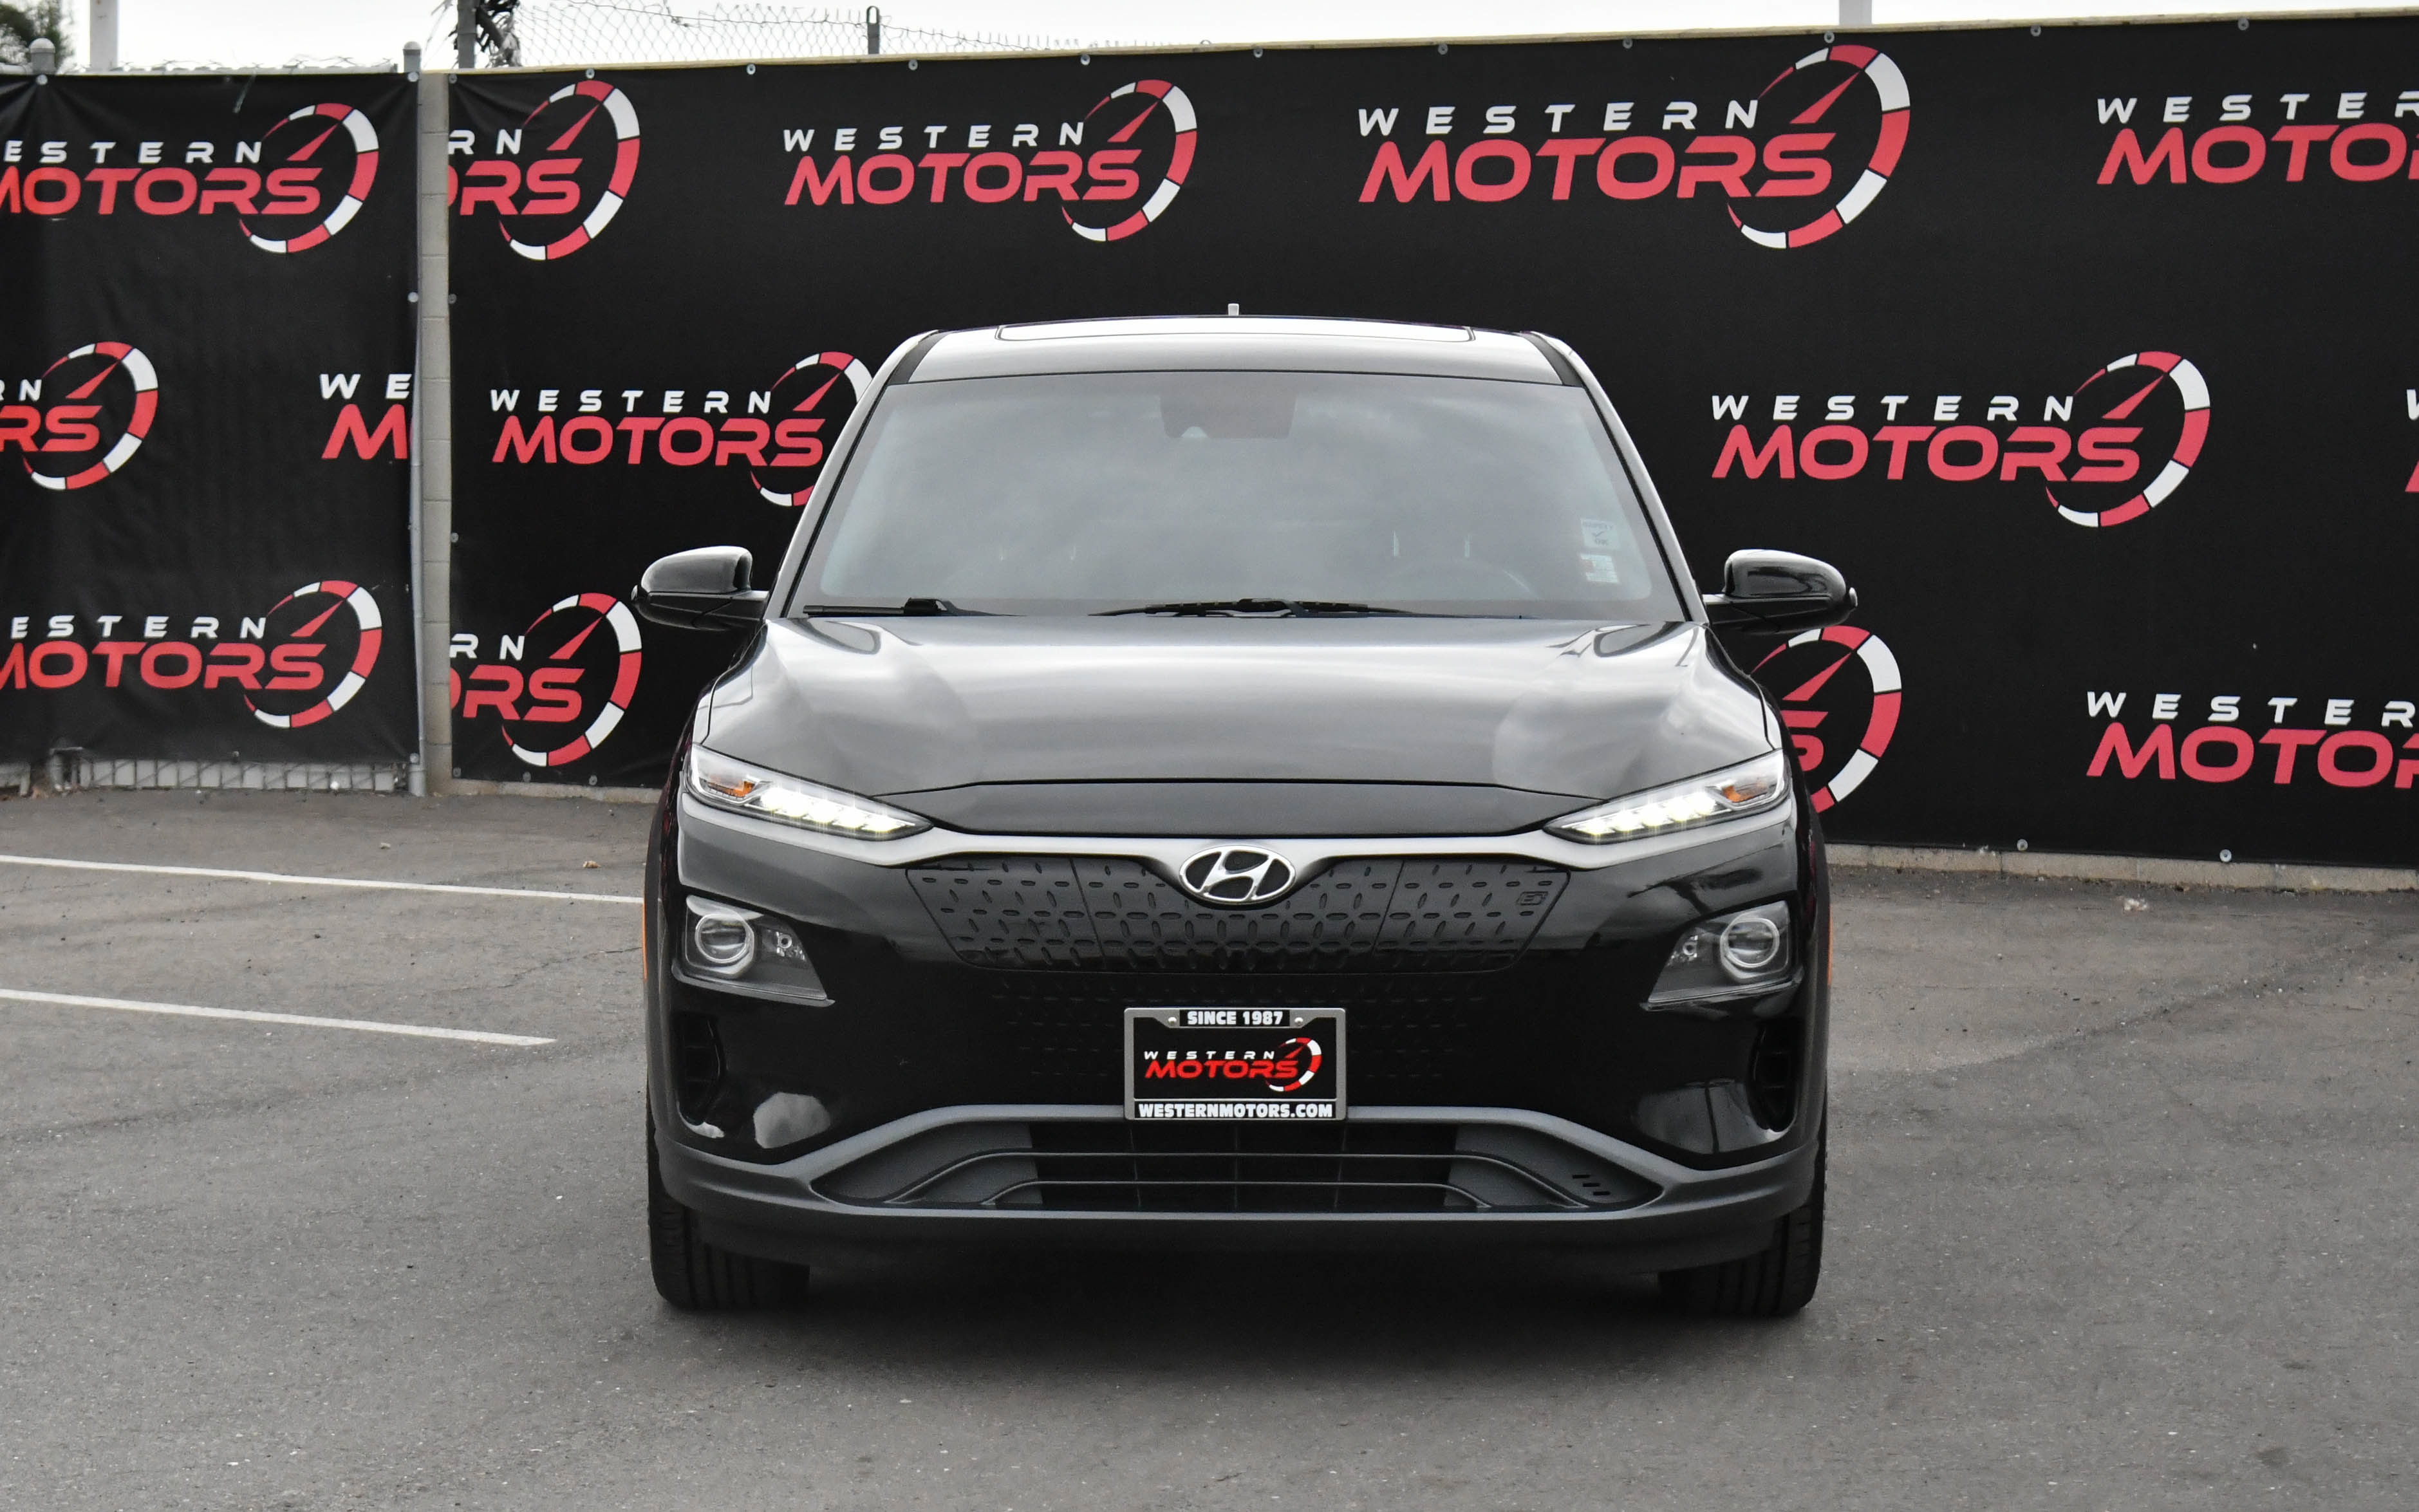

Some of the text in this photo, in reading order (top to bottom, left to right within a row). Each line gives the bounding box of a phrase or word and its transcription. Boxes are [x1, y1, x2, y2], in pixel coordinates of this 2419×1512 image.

[1358, 99, 1758, 136] WESTERN
[2097, 91, 2419, 124] WESTER
[4, 140, 262, 163] ESTERN
[448, 129, 522, 155] RN
[783, 122, 1084, 152] WESTERN
[1359, 132, 1836, 203] MOTORS
[2097, 123, 2419, 185] MOTO
[448, 158, 583, 216] RS
[784, 149, 1142, 206] MOTORS
[0, 379, 42, 402] N
[319, 373, 412, 400] WE
[490, 389, 771, 414] WESTERN
[1712, 395, 2073, 422] WESTERN
[321, 404, 413, 460] M
[492, 415, 826, 467] MOTORS
[1712, 424, 2143, 483] MOTORS
[10, 615, 266, 639] ESTERN
[449, 633, 525, 661] RN
[450, 664, 586, 723] RS
[2087, 691, 2416, 728] WESTER
[1187, 1011, 1283, 1025] SINCE 1987
[1144, 1050, 1275, 1060] WESTERN
[1144, 1059, 1299, 1079] MOTORS
[1138, 1103, 1332, 1118] WESTERNMOTORS.COM
